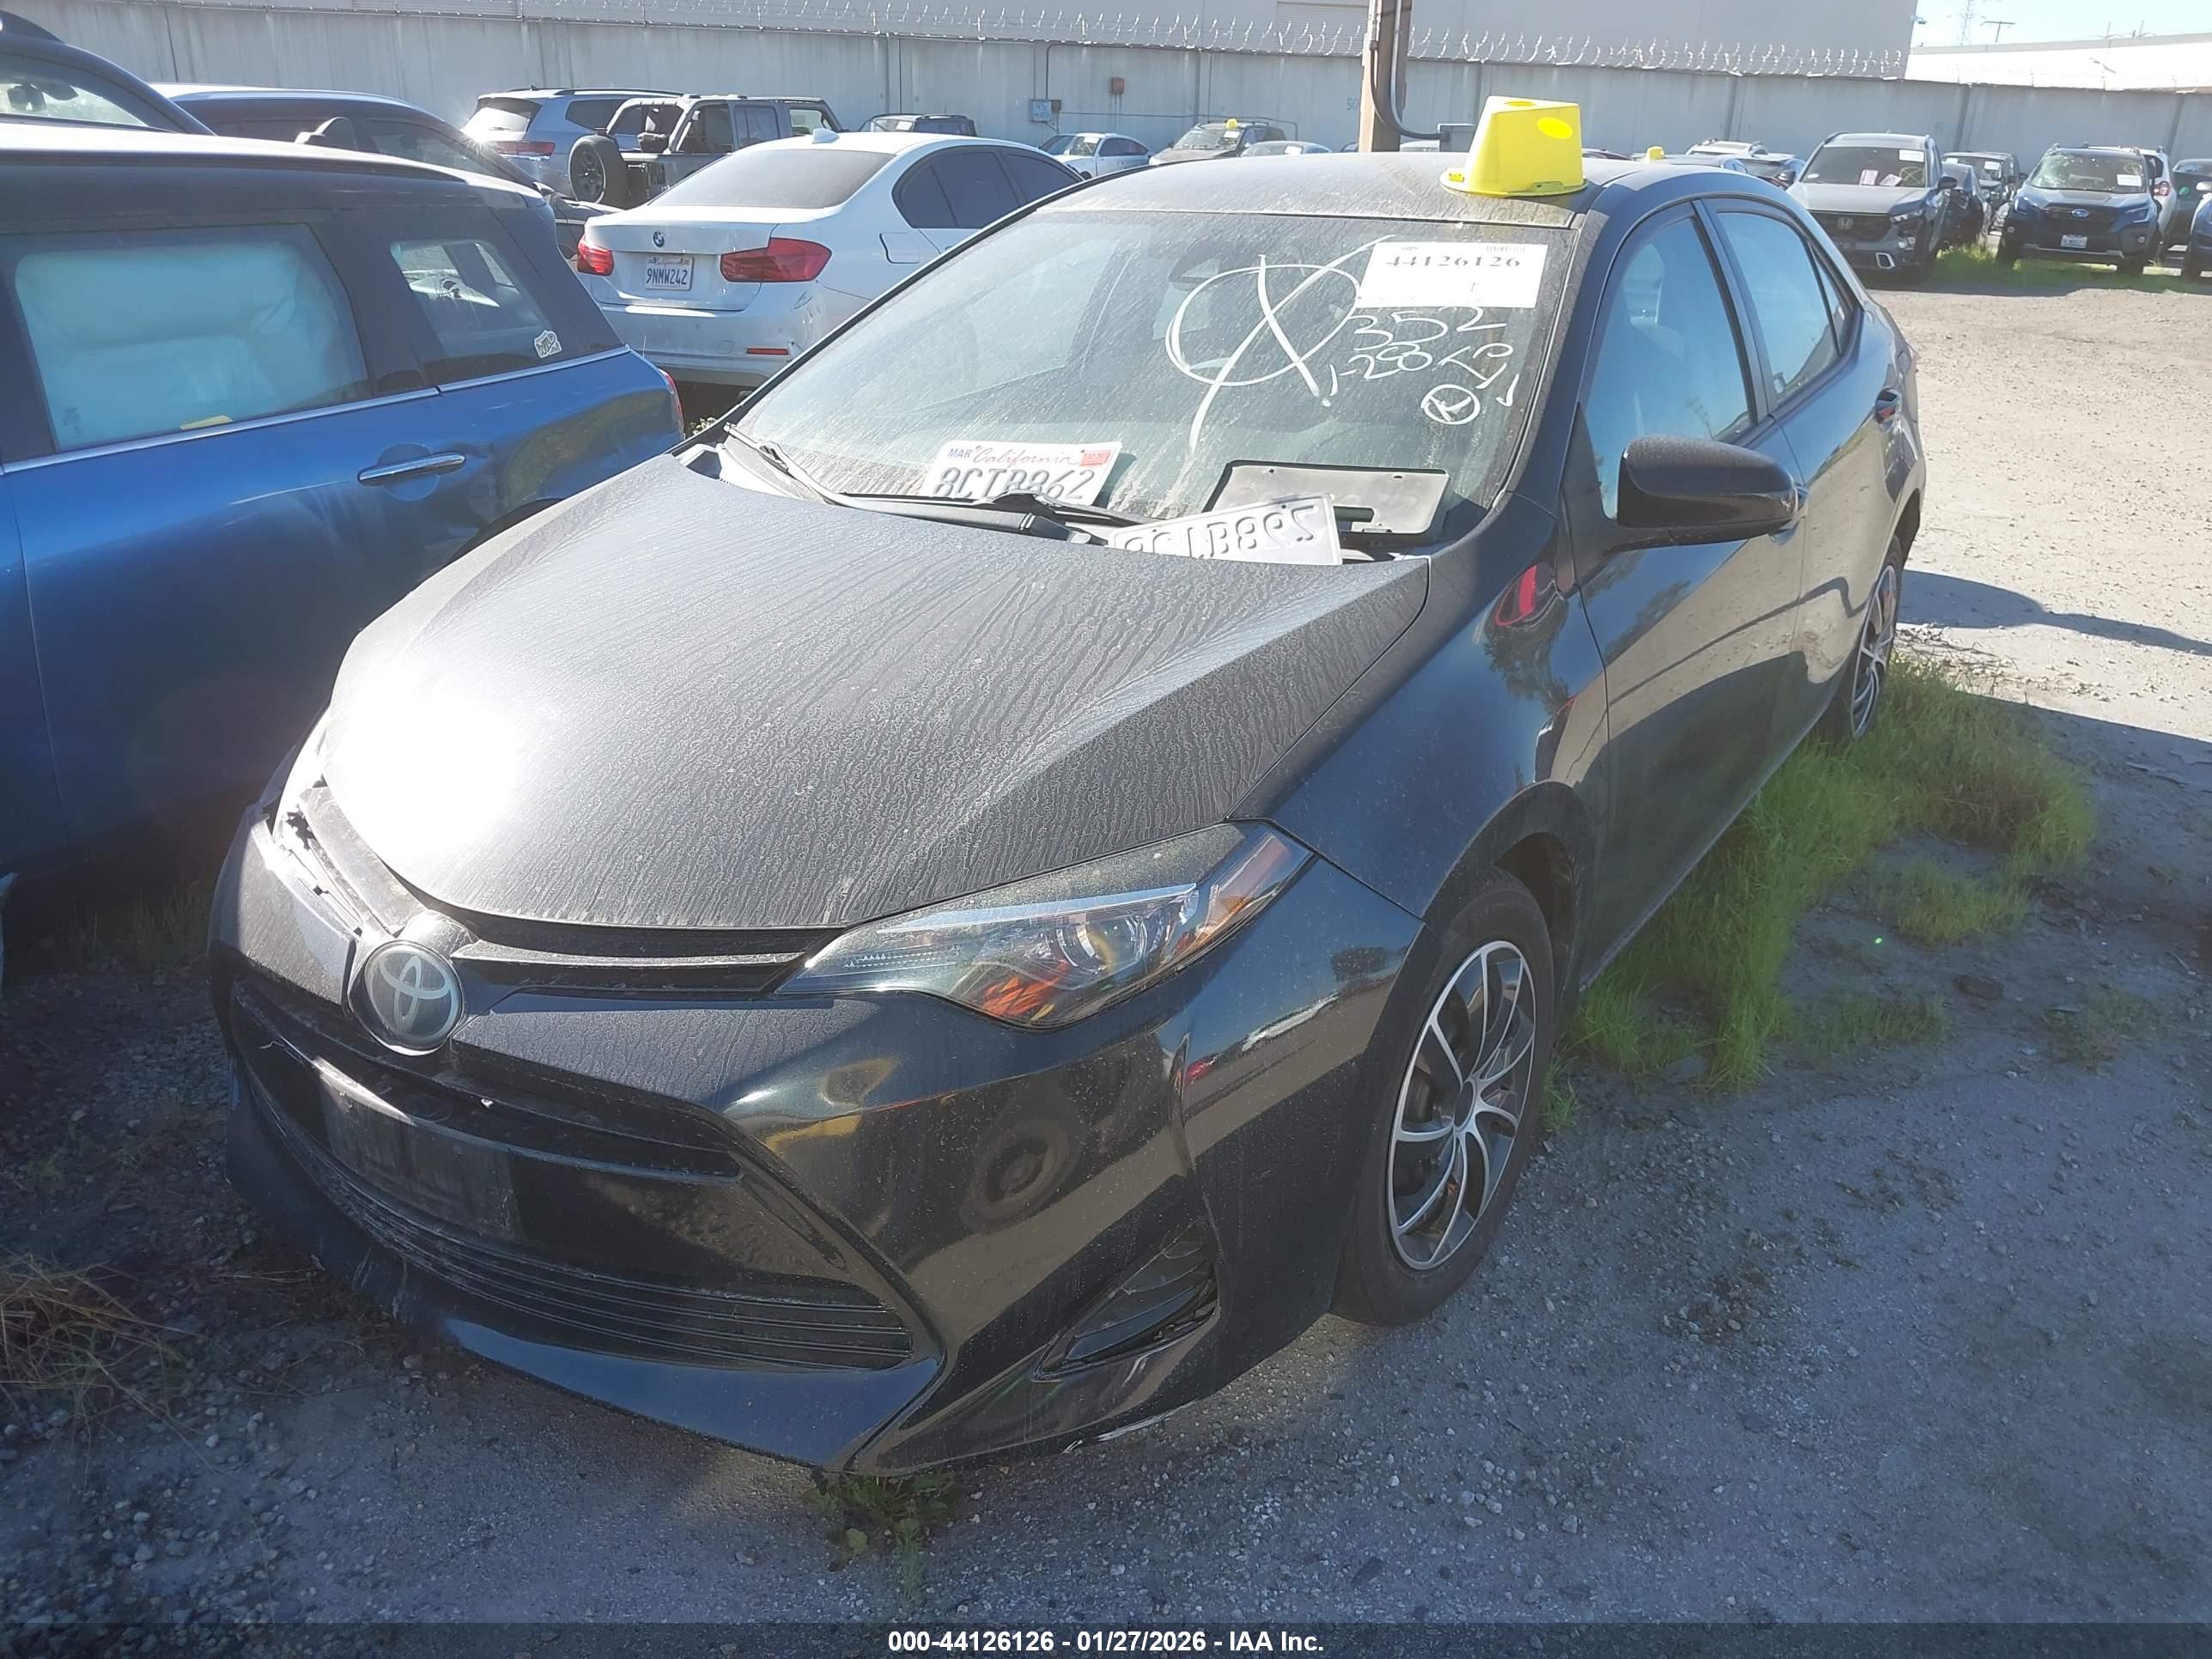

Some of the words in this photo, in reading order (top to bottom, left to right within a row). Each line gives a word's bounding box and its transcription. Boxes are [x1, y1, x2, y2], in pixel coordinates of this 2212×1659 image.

[1386, 255, 1520, 266] 44126126
[646, 268, 688, 285] 9NMW242
[1349, 307, 1506, 351] 352
[947, 447, 972, 459] MAR
[973, 445, 1079, 468] California
